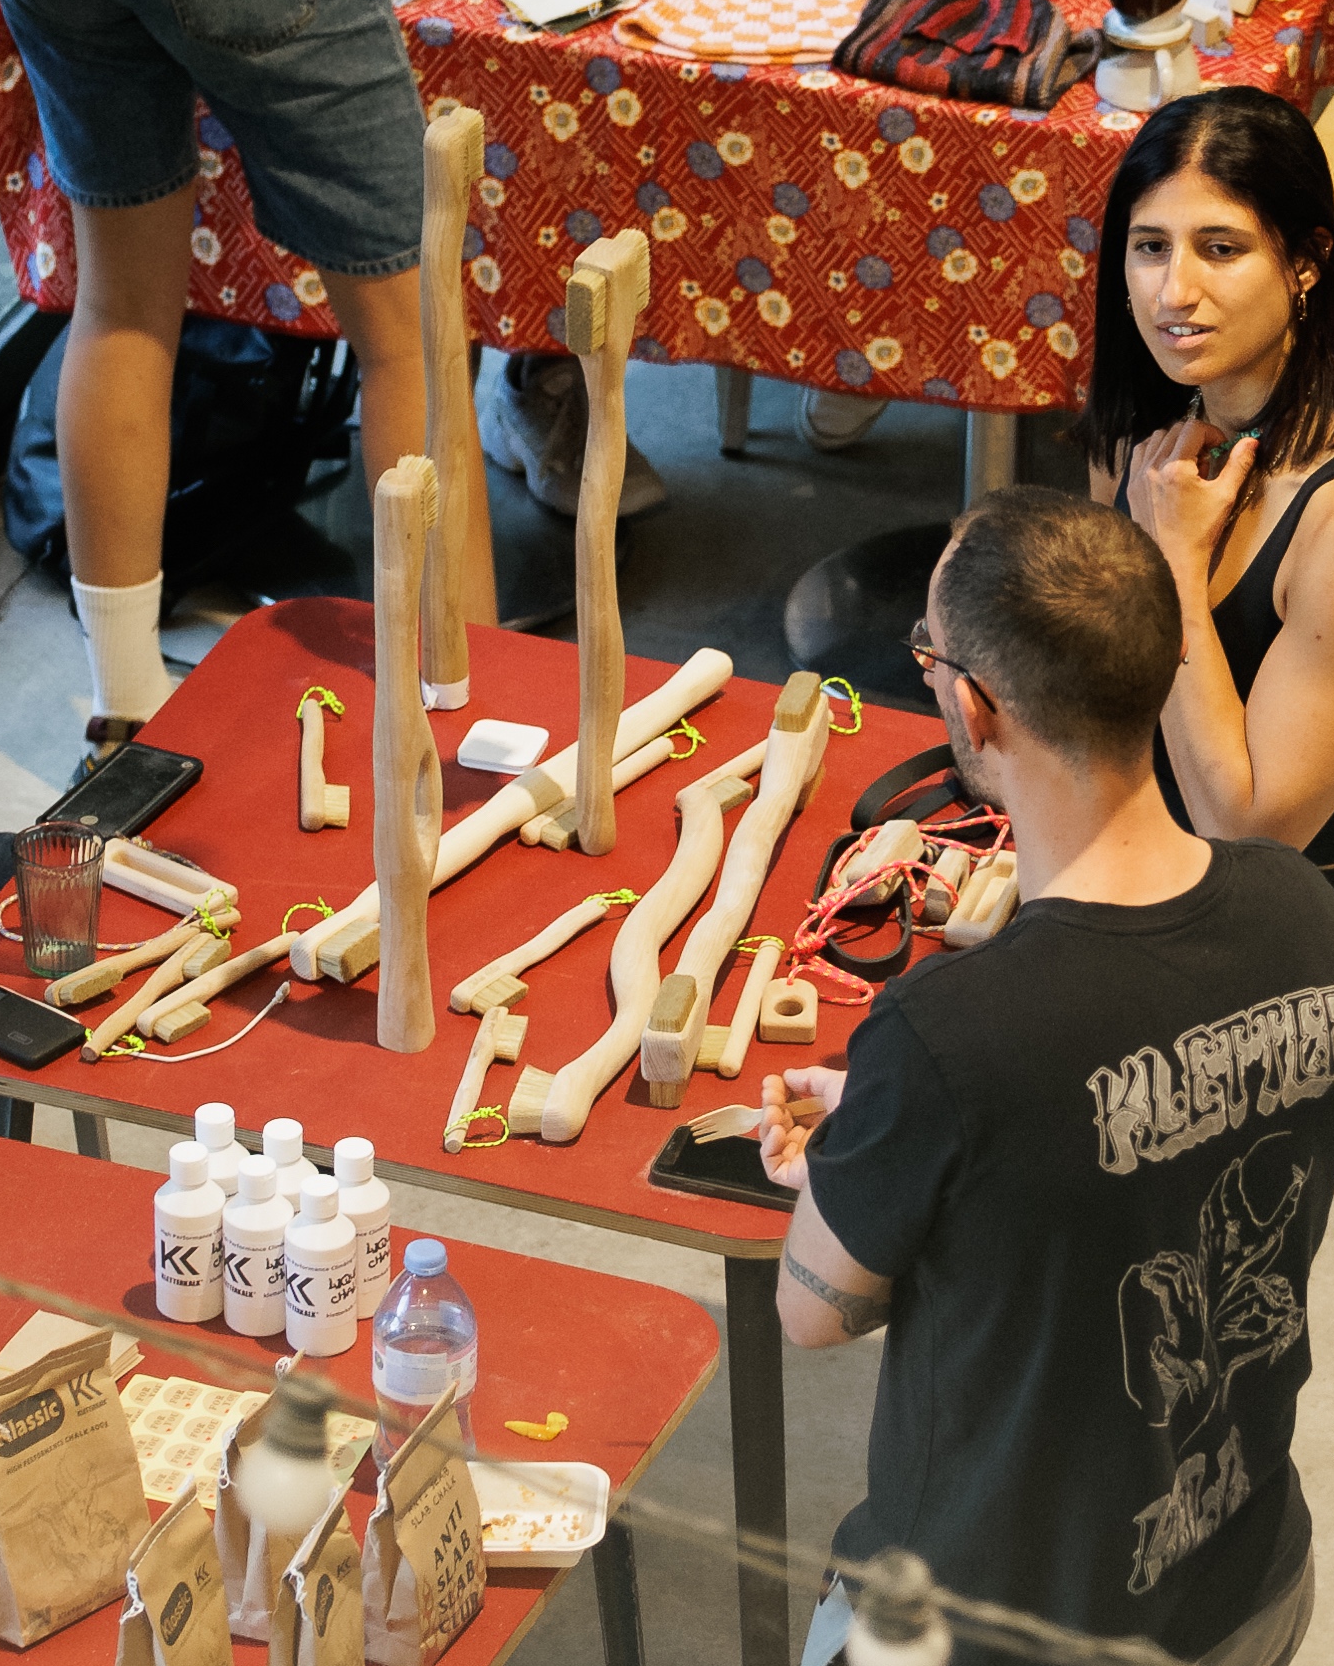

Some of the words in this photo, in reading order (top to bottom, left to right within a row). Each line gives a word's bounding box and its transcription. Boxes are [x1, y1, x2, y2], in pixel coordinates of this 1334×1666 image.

[65, 1429, 88, 1443] CHALK
[410, 1506, 431, 1529] SLAB
[432, 1475, 457, 1506] CHALK
[433, 1500, 463, 1571] ANTI
[437, 1528, 471, 1593] SLAB
[438, 1559, 475, 1615] SLAB
[438, 1591, 479, 1635] CLUB
